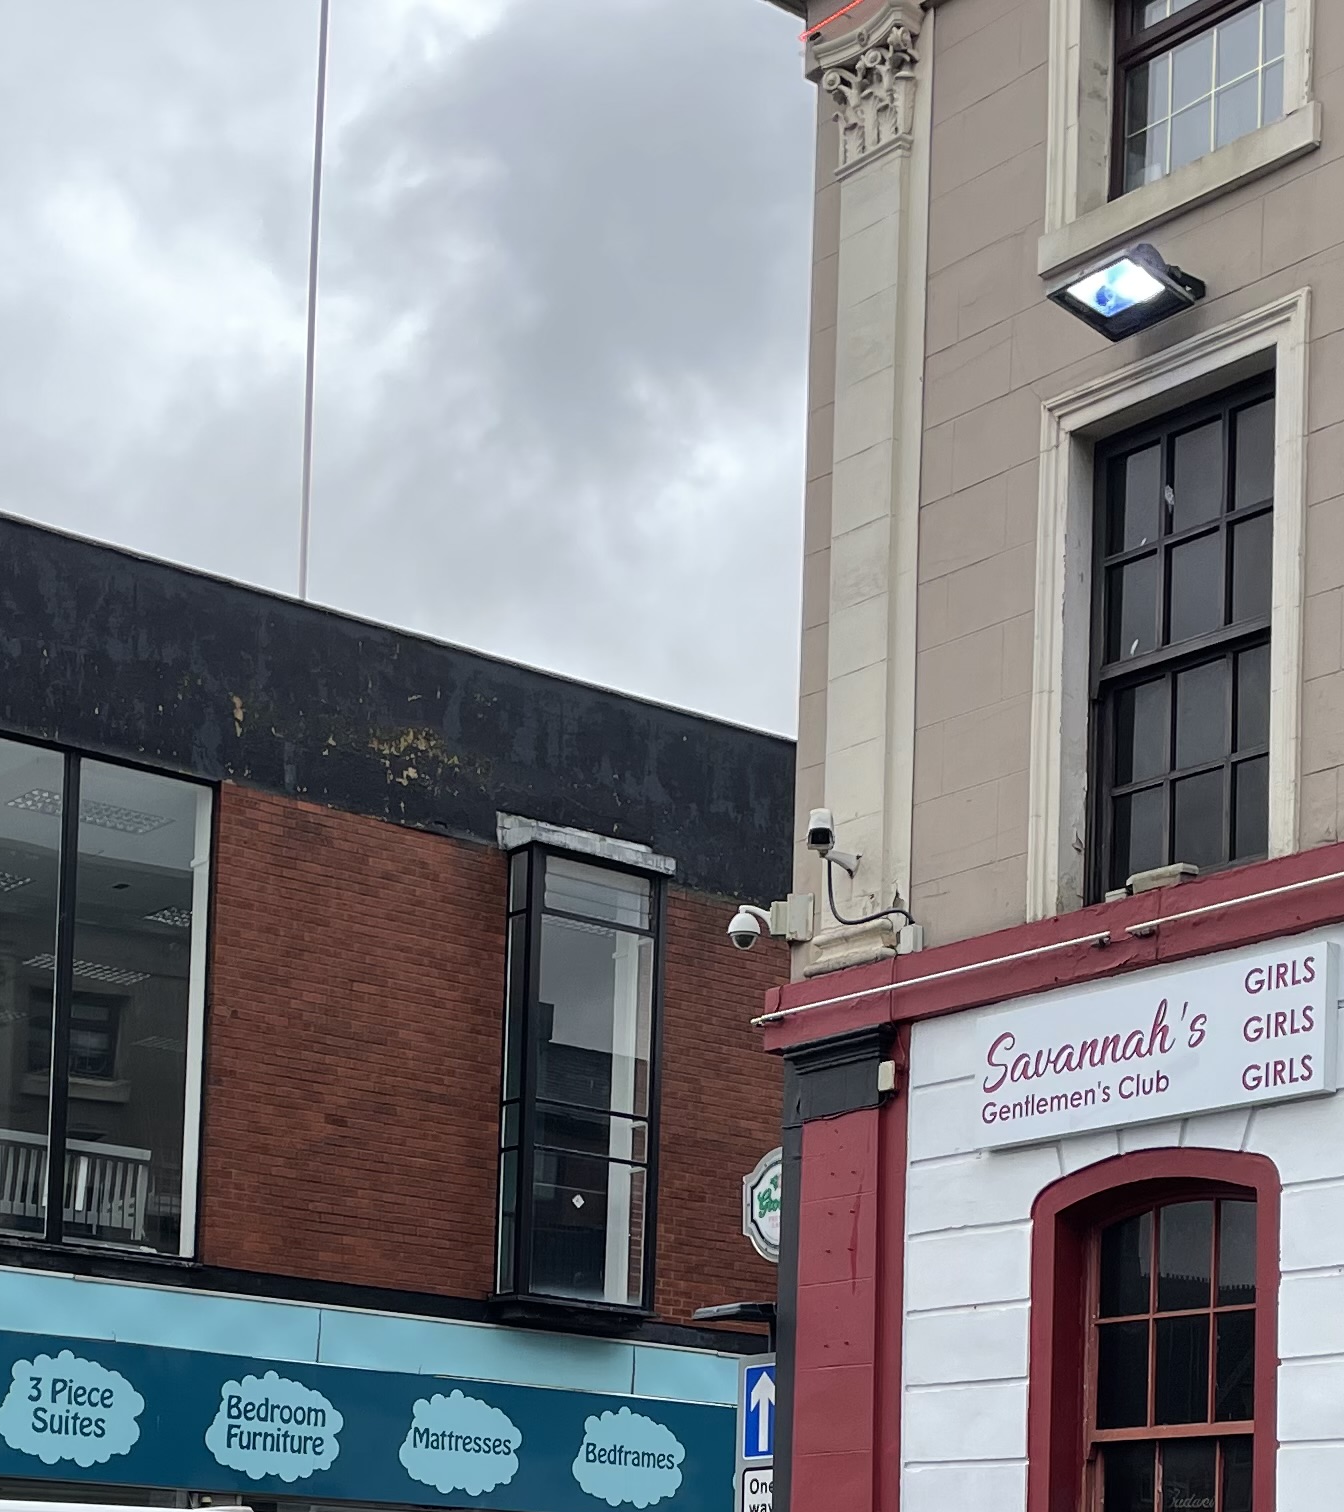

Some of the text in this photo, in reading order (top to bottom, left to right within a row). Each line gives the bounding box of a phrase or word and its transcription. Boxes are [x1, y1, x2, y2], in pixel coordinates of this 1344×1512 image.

[1245, 956, 1317, 995] GIRLS
[1243, 1005, 1315, 1043] GIRLS
[982, 998, 1208, 1094] Savannah's
[1241, 1054, 1314, 1092] GIRLS
[981, 1070, 1170, 1125] Gentlemen's Club
[27, 1376, 114, 1409] 3 Piece
[31, 1406, 106, 1439] Suites
[226, 1394, 327, 1428] Bedroom
[225, 1423, 325, 1456] Furniture
[412, 1426, 512, 1456] Mattresses
[585, 1442, 676, 1470] Bedframes
[748, 1478, 773, 1495] One
